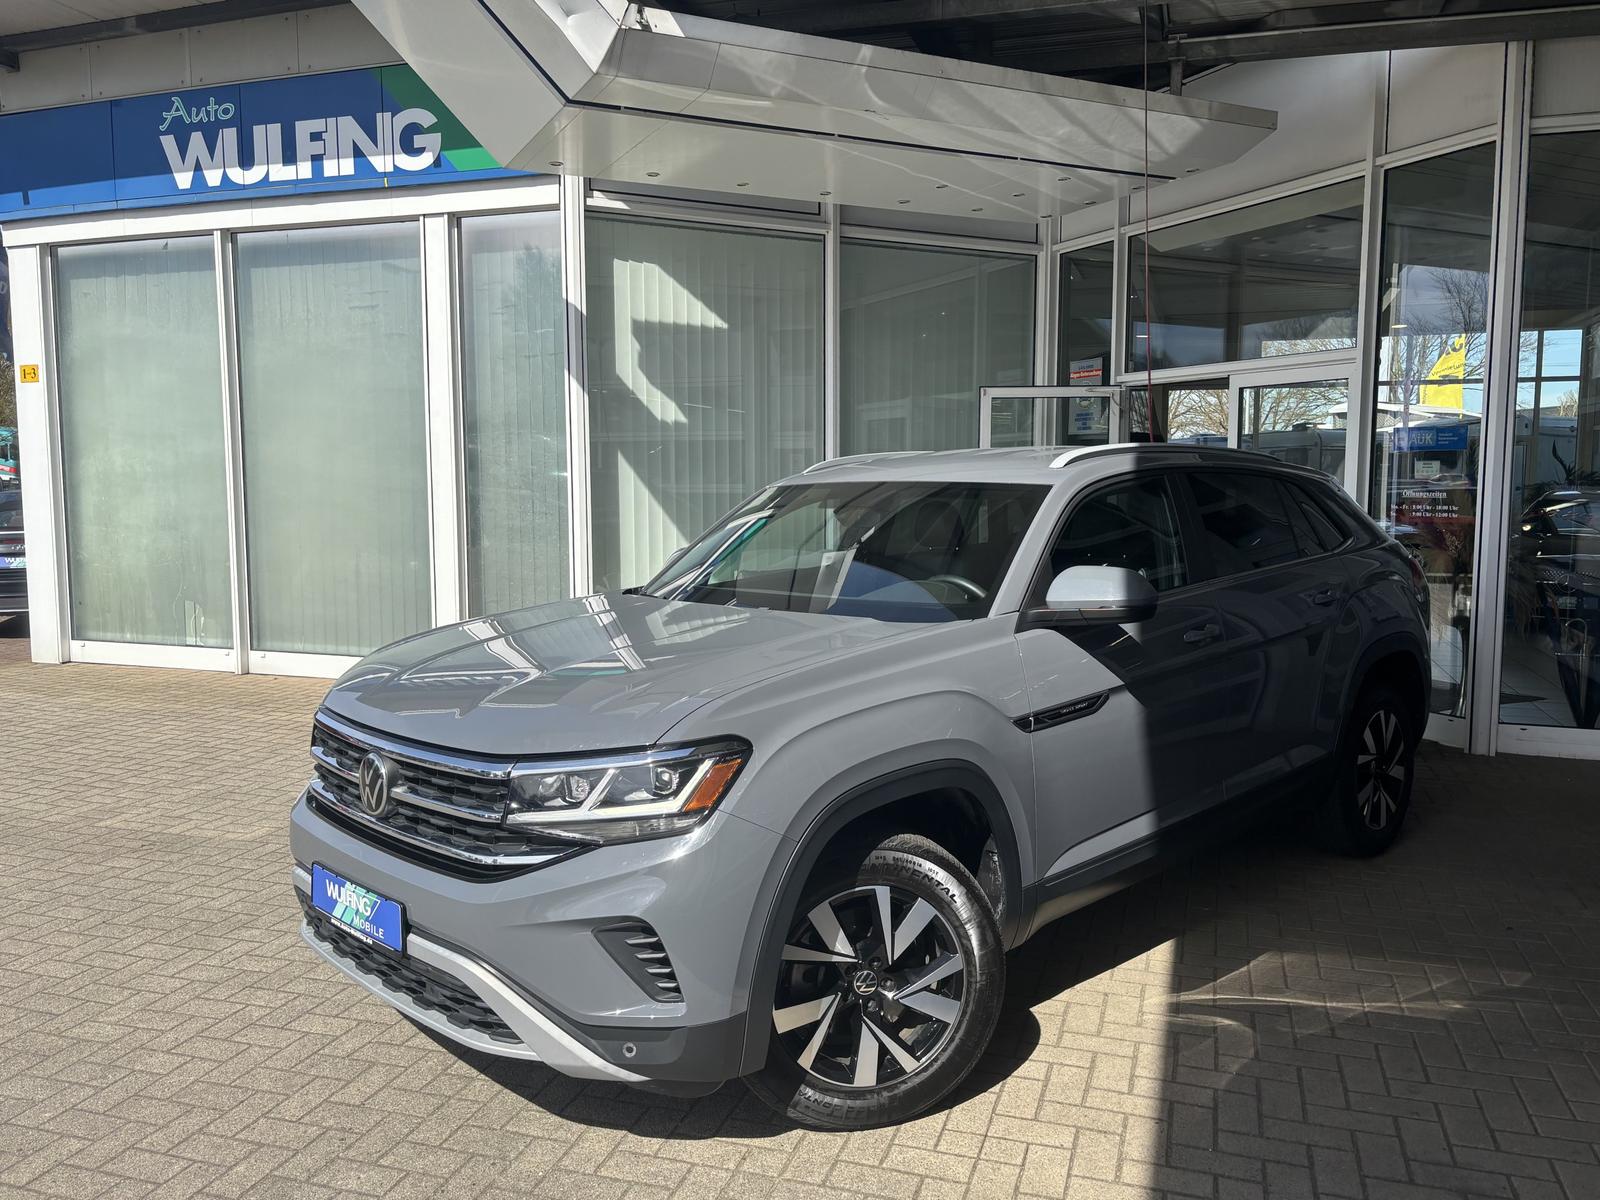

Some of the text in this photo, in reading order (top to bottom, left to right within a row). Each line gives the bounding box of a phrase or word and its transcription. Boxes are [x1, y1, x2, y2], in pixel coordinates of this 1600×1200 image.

[159, 96, 235, 131] Auto
[159, 107, 442, 190] WULFING
[20, 368, 37, 380] 1-3
[1402, 488, 1447, 499] Öffnungszeiten
[325, 879, 372, 917] WULFING
[353, 913, 384, 939] MOBILE
